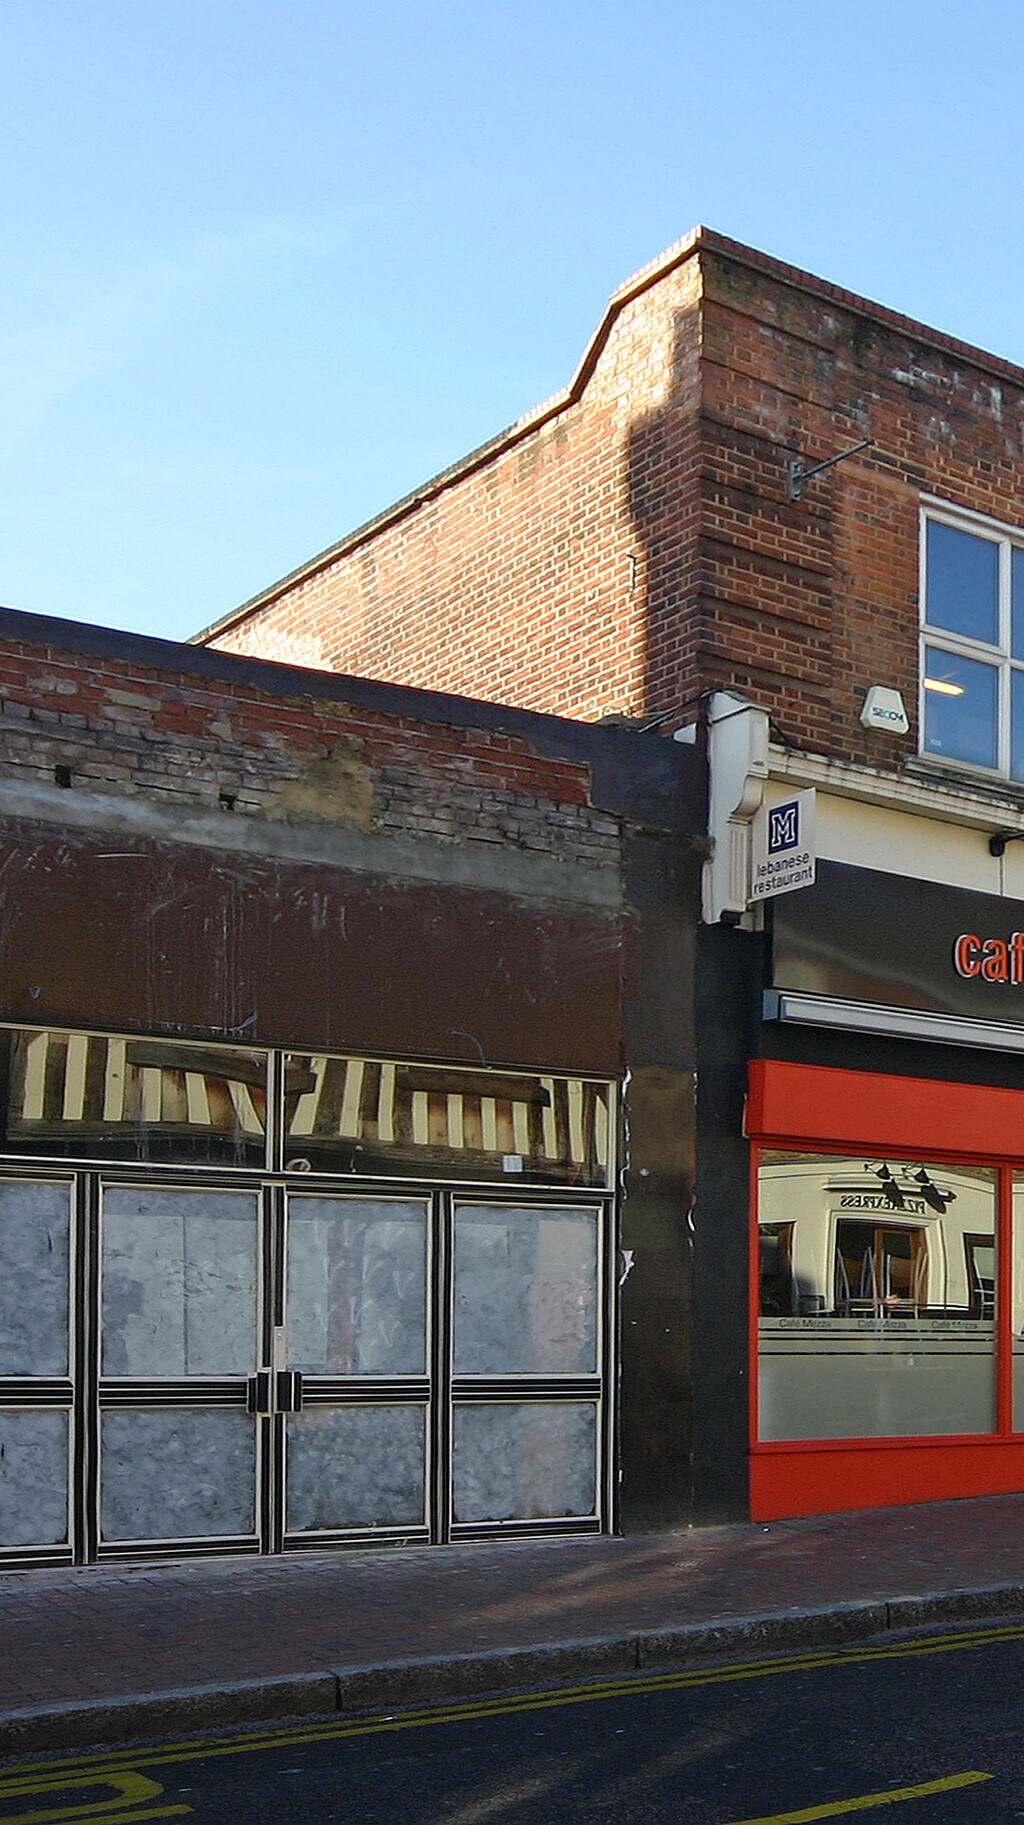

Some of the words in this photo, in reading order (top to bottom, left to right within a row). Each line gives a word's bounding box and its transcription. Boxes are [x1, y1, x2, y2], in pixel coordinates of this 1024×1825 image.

[771, 808, 796, 848] M
[757, 852, 810, 877] lebanese
[754, 866, 813, 894] restaurant
